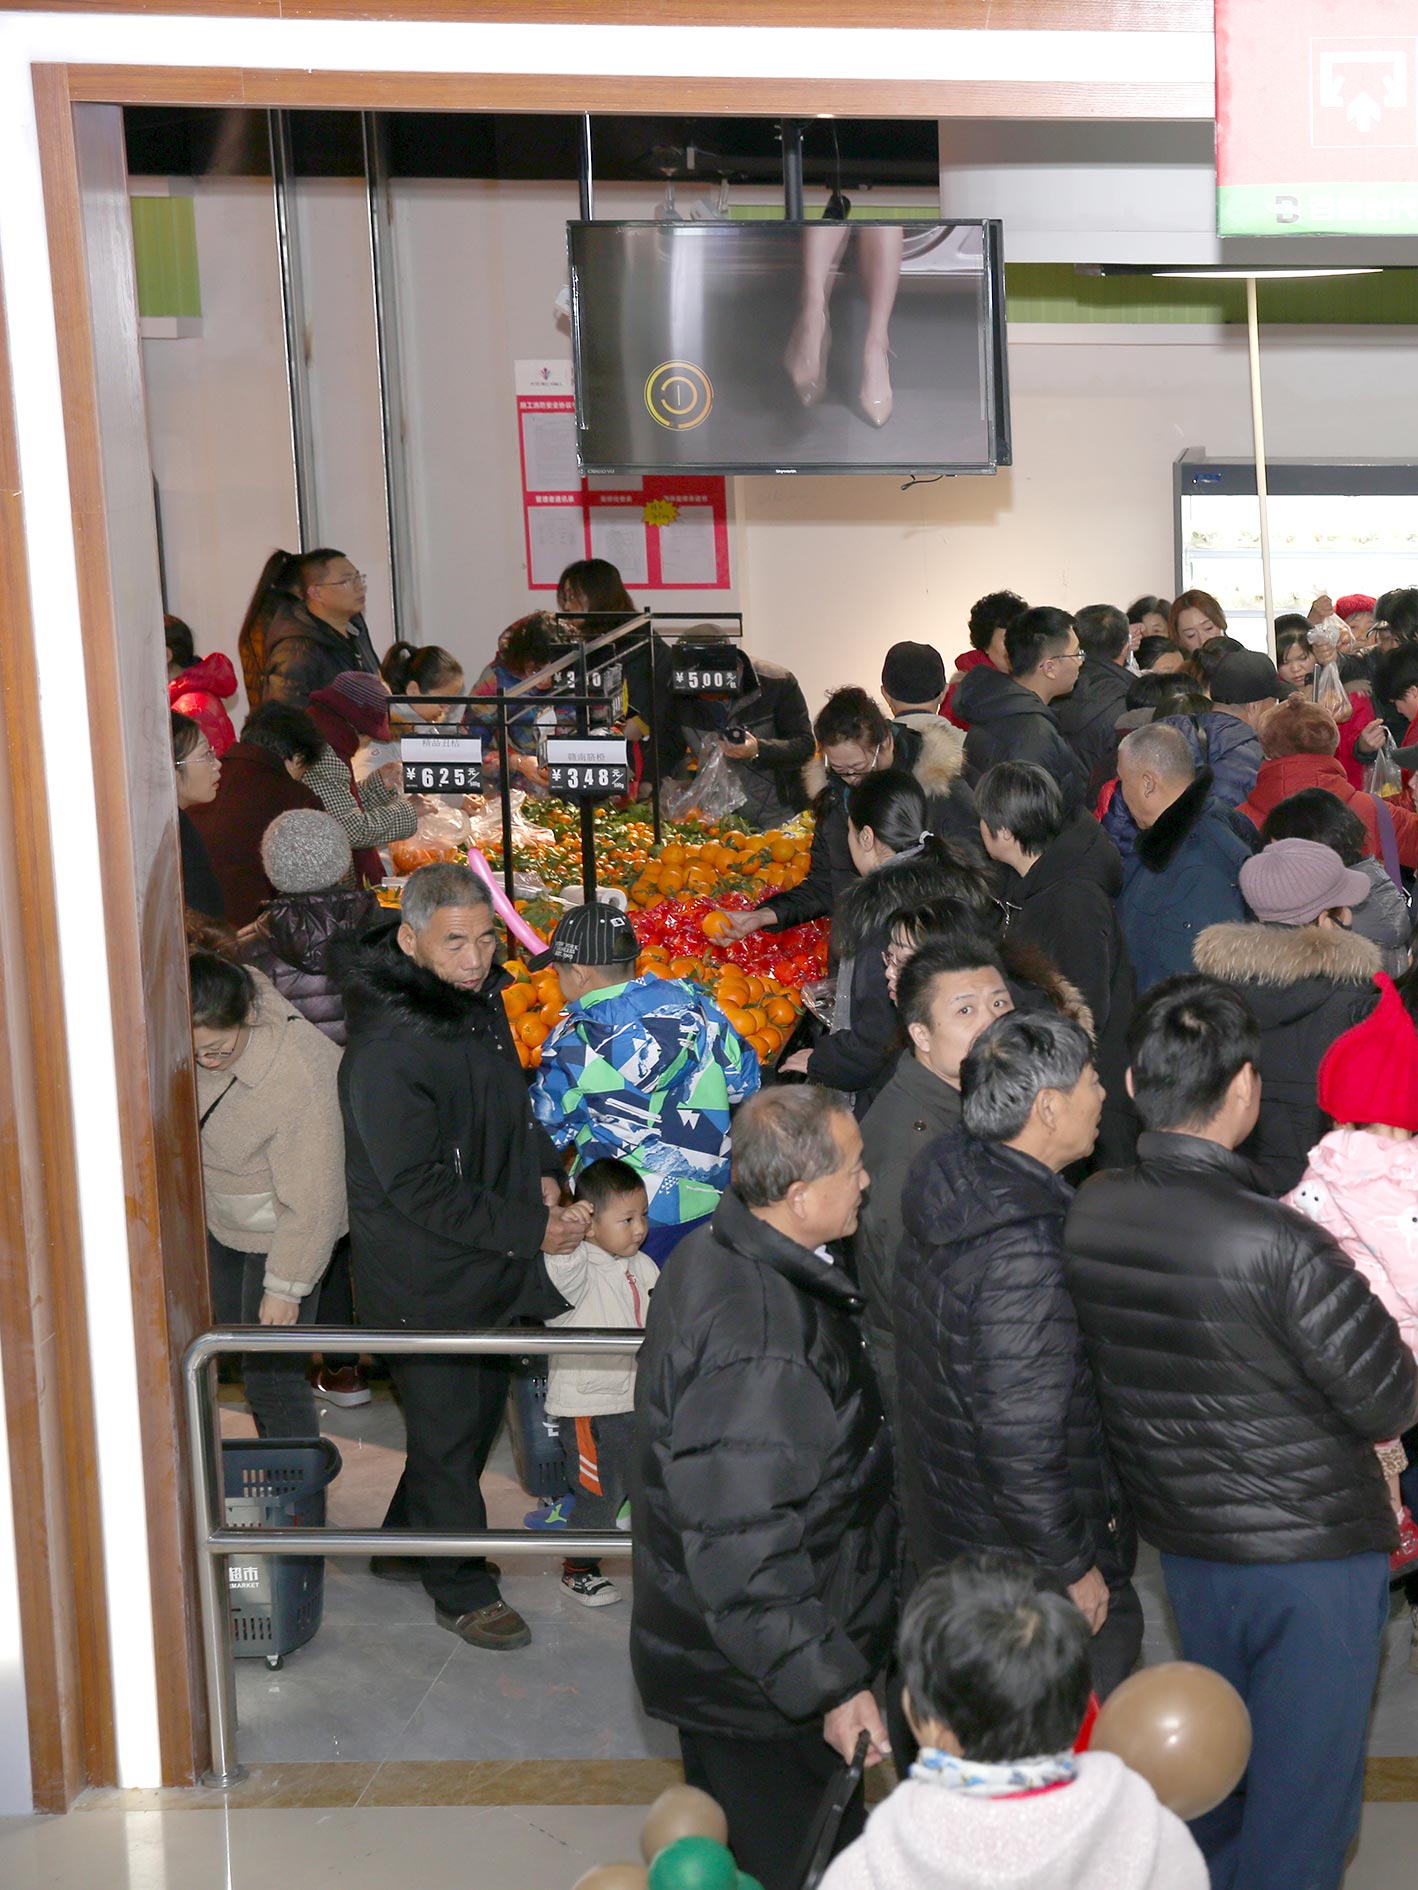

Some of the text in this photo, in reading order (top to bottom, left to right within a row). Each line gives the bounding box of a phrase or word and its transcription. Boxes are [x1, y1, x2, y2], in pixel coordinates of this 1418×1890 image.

[688, 671, 723, 689] 5.00
[421, 767, 465, 788] 6.25
[567, 768, 609, 789] 3.48
